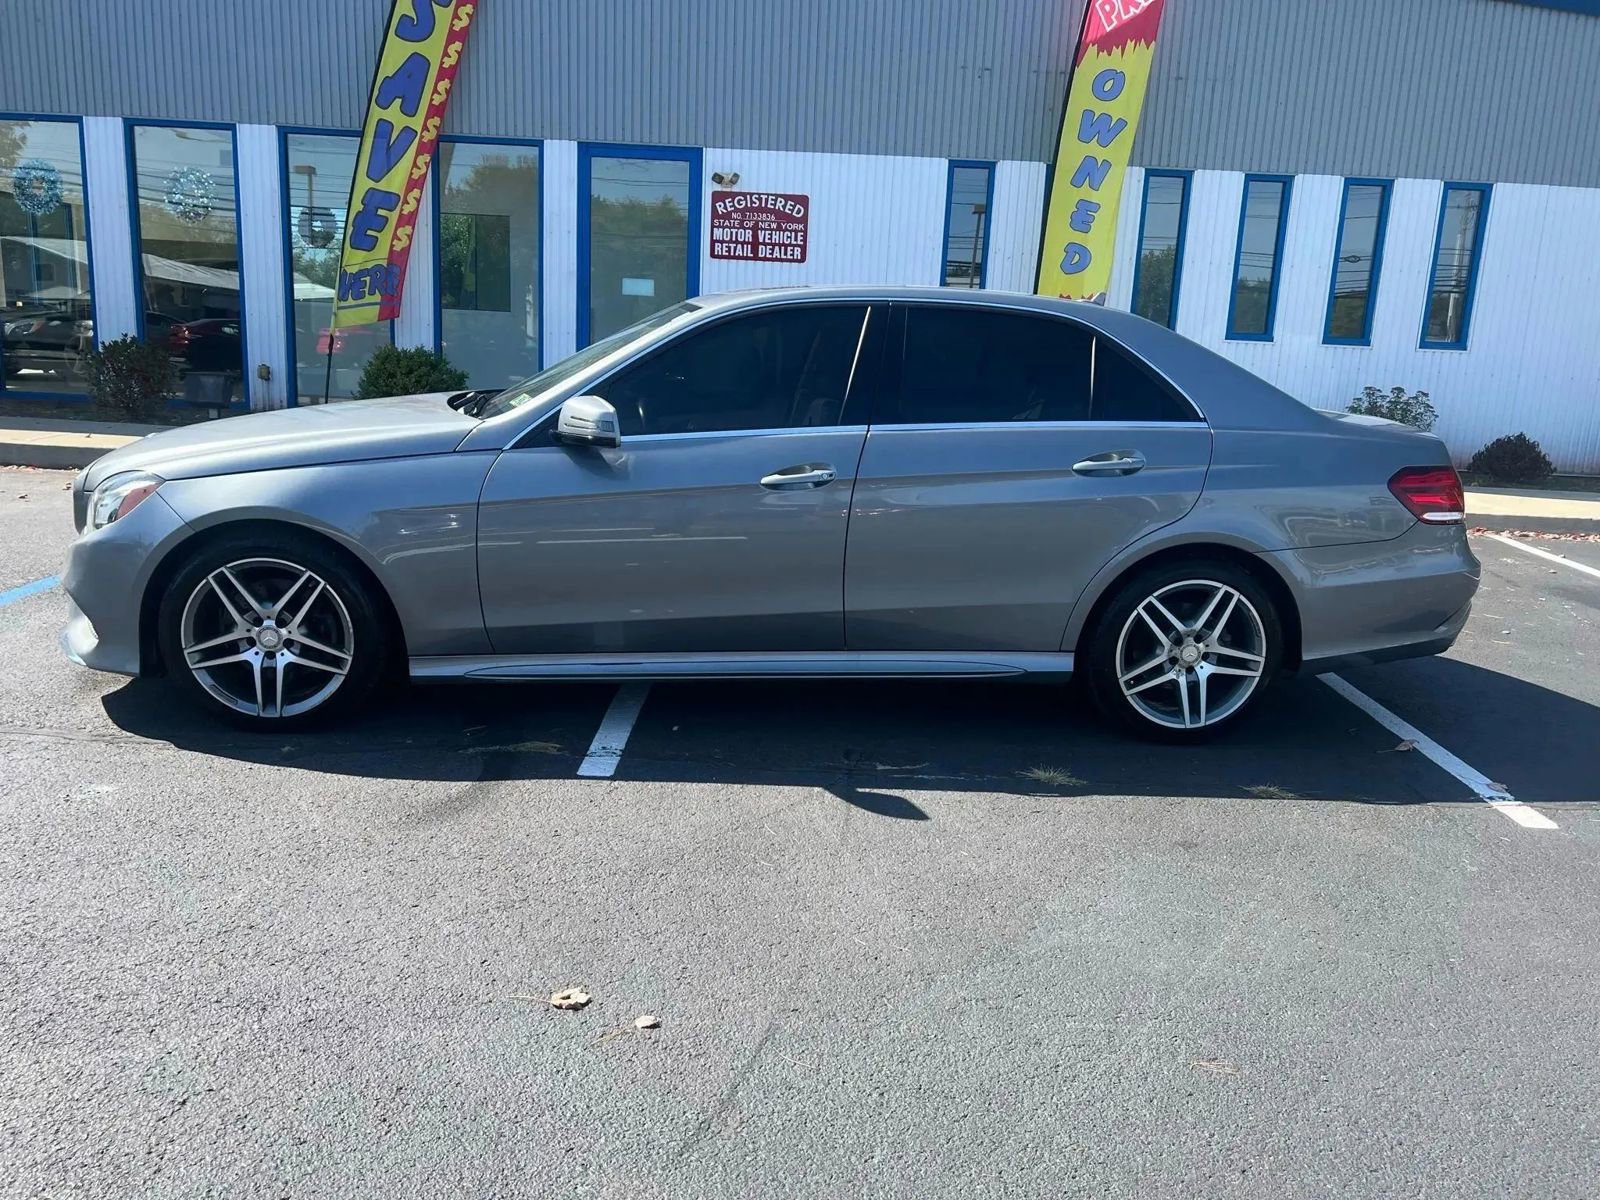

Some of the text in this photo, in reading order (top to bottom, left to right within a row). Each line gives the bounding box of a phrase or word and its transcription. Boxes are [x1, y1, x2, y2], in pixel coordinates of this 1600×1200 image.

[350, 0, 453, 252] SAVE
[1059, 68, 1128, 275] OWNED
[715, 194, 805, 218] REGISTERED
[713, 219, 805, 231] STATE OF NEW YORK
[713, 227, 804, 245] MOTOR VEHICLE
[714, 242, 801, 260] RETAIL DEALER
